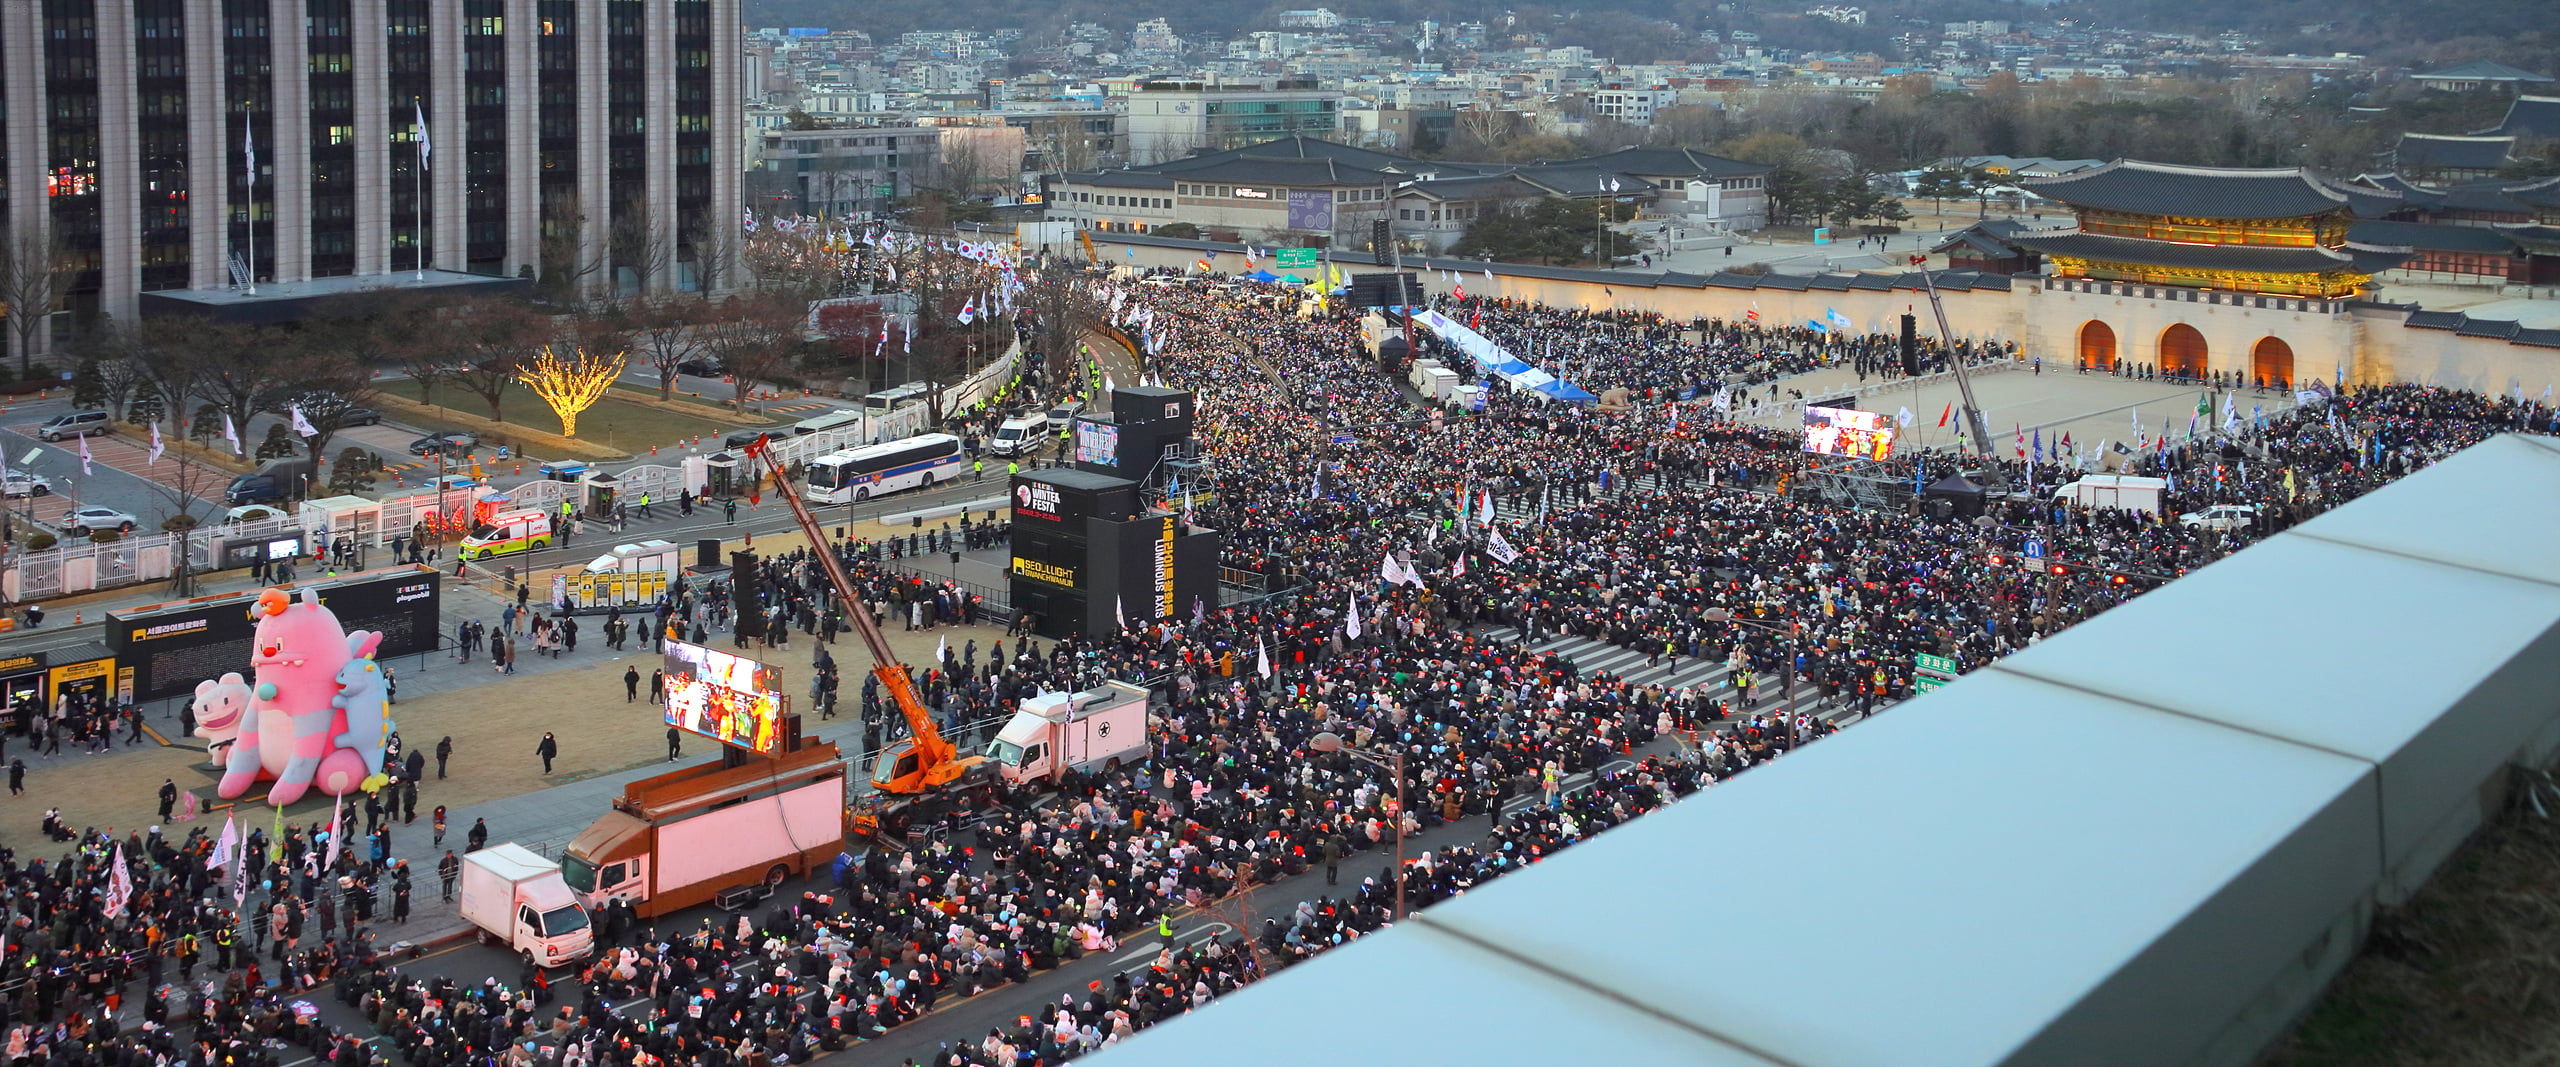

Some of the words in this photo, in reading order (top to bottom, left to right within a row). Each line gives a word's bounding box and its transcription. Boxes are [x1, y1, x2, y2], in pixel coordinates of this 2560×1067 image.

[1032, 488, 1060, 504] WINTER
[1033, 499, 1056, 514] FESTA
[1155, 539, 1165, 592] LUMINOUS
[396, 591, 430, 603] playmobil
[1155, 595, 1165, 619] AXIS
[1922, 655, 1951, 671] 광화문
